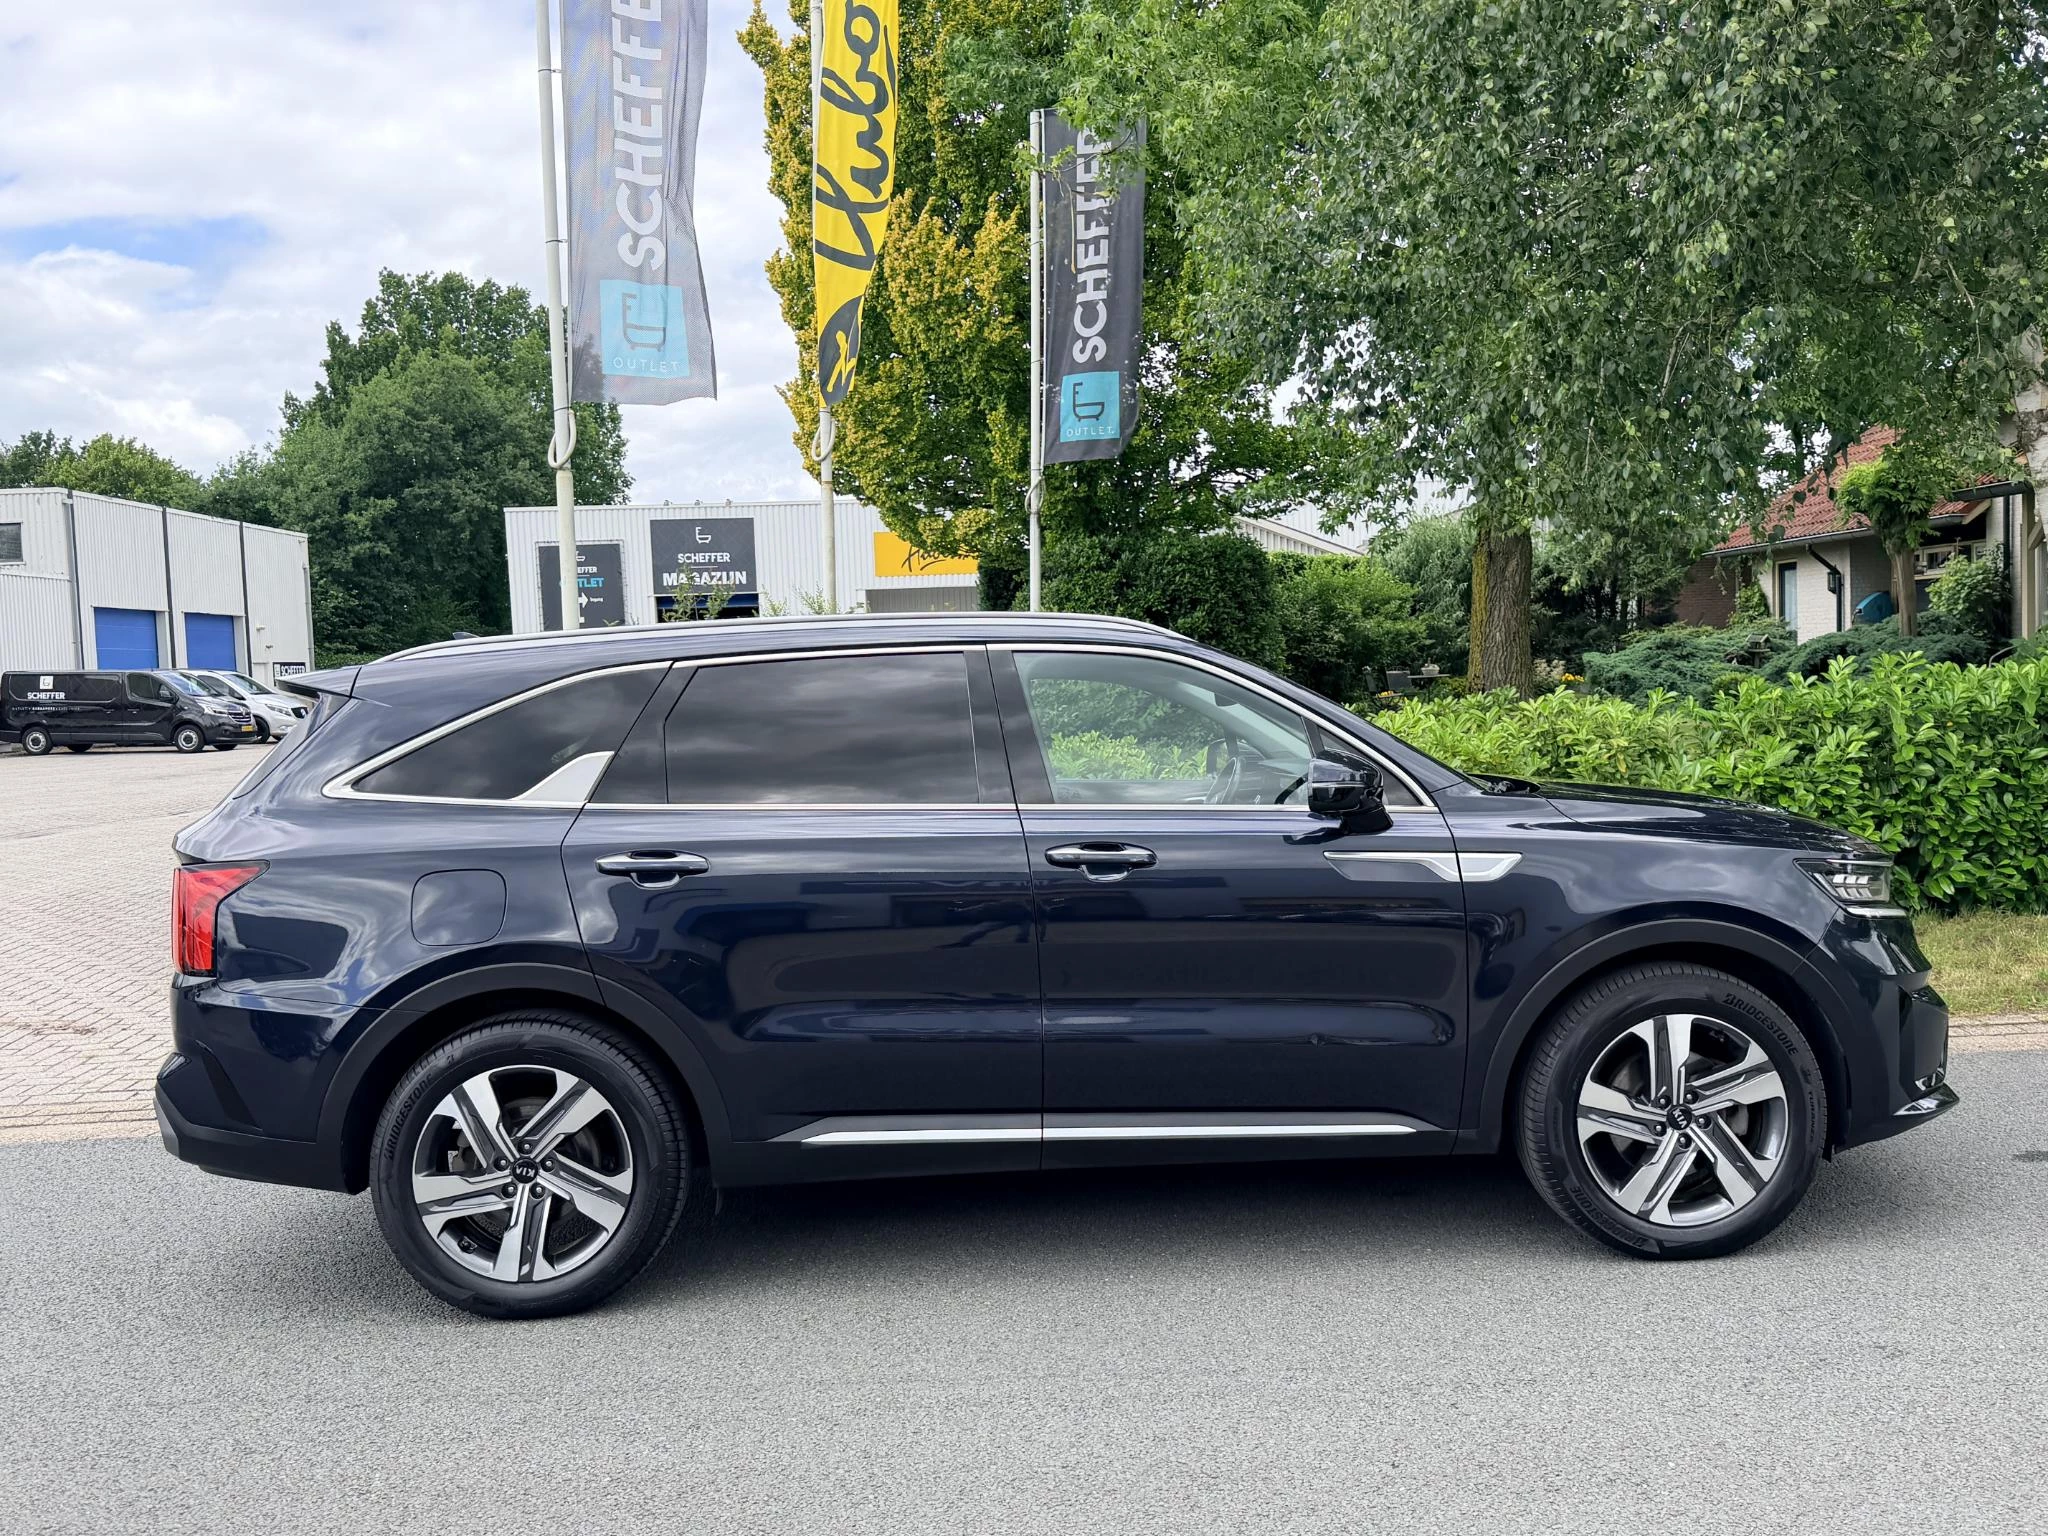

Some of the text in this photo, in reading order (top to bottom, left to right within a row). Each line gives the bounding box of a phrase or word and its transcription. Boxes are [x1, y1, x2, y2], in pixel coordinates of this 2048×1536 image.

[677, 552, 731, 563] SCHEFFER
[662, 571, 747, 586] MAGAZIJN
[27, 691, 66, 700] SCHEFFER
[1723, 992, 1799, 1056] BRIDGESTONE
[1672, 1108, 1688, 1129] KIA
[515, 1165, 536, 1178] KIA
